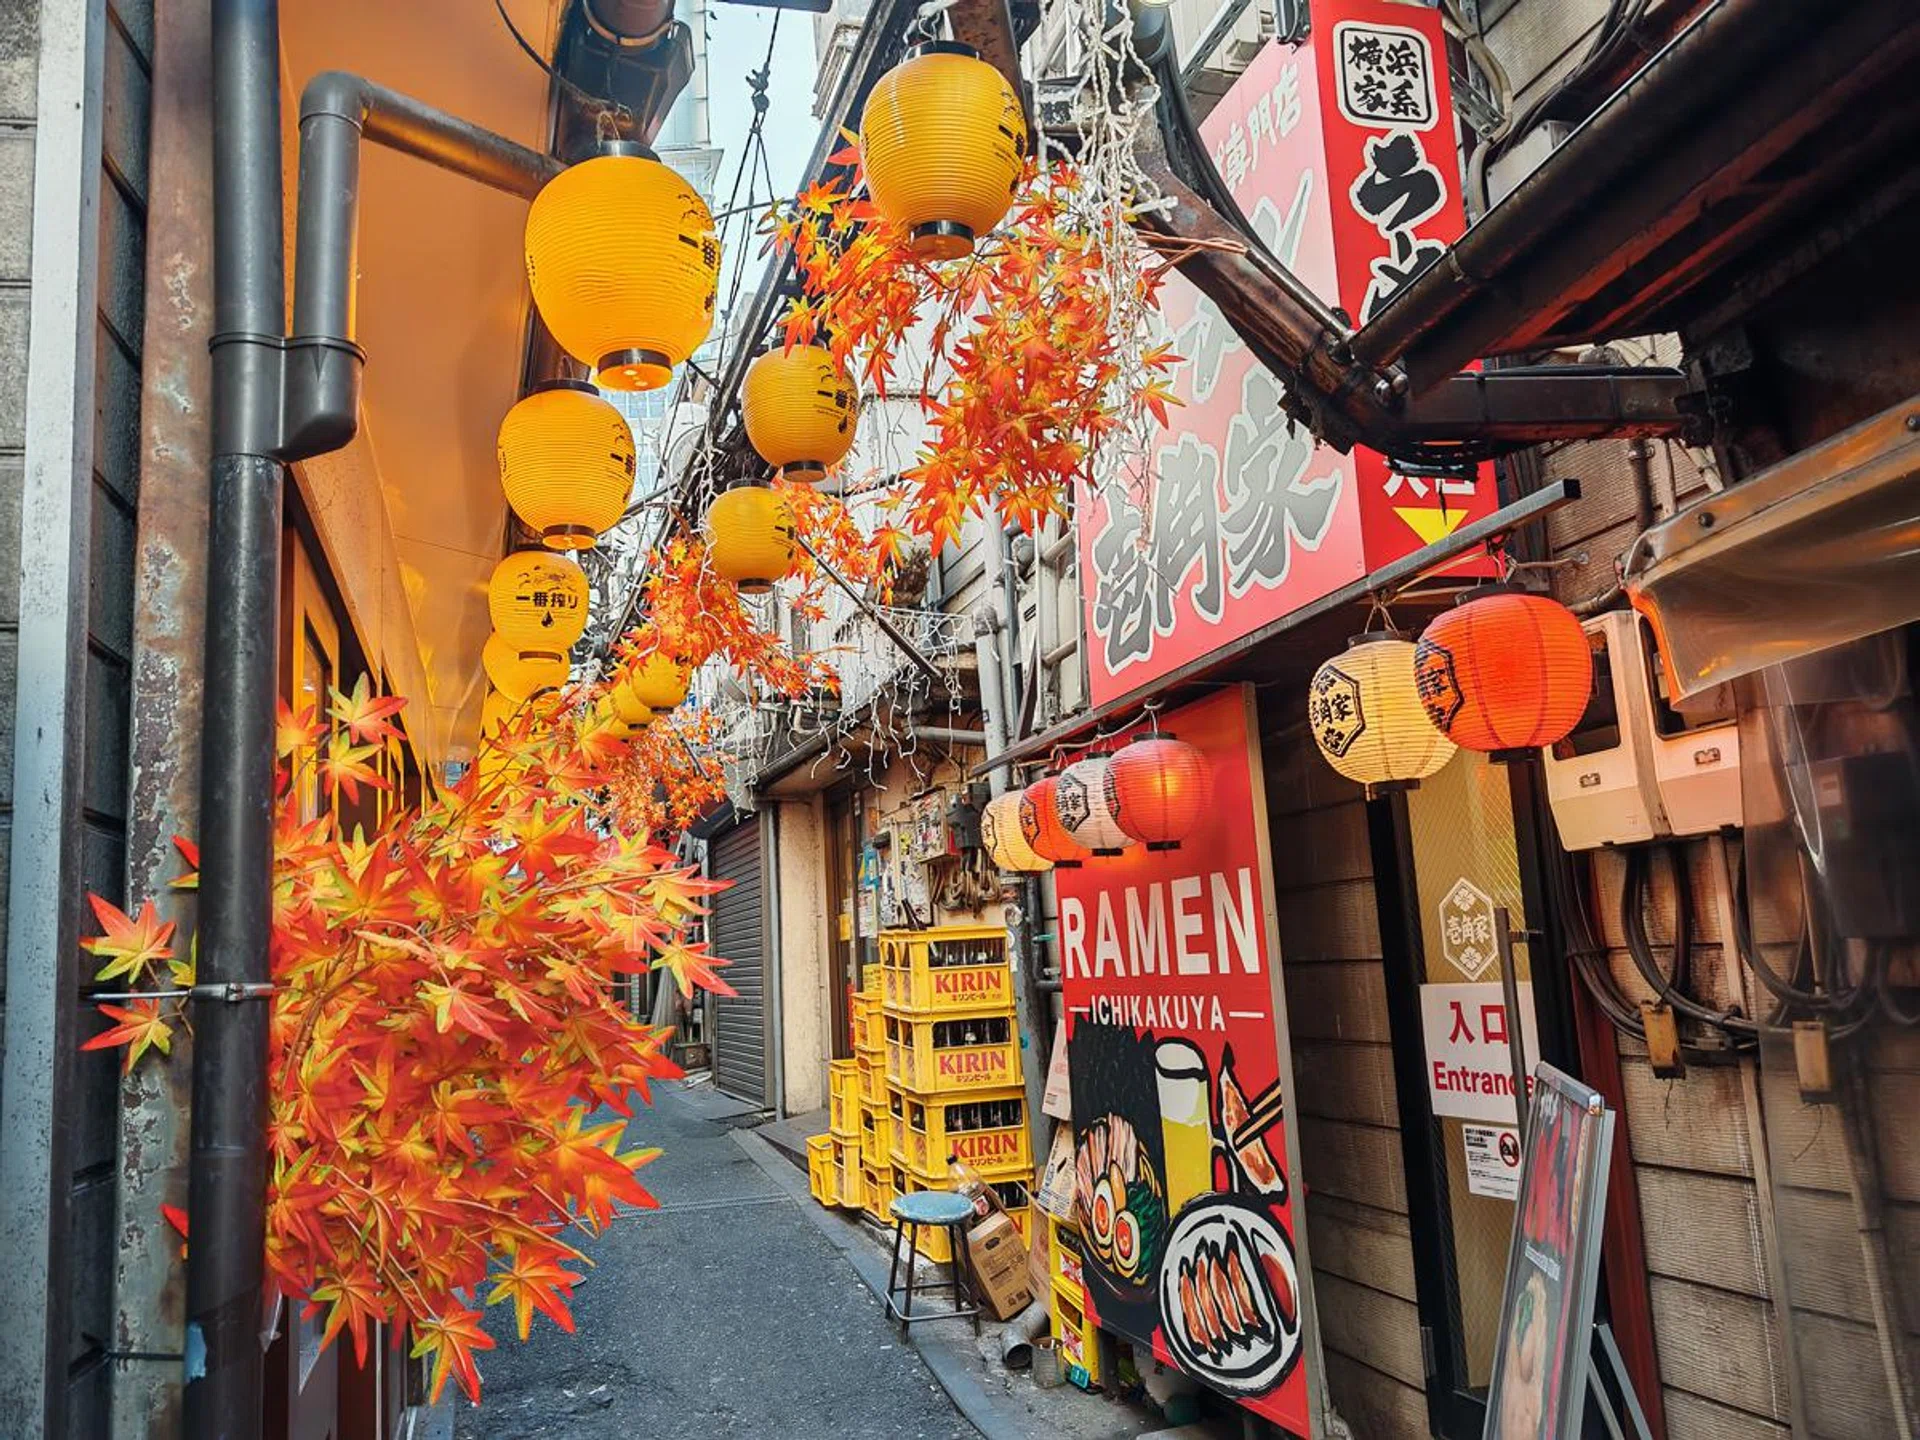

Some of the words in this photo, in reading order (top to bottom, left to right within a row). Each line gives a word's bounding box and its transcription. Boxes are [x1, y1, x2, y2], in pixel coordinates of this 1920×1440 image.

[1347, 35, 1420, 78] 横浜
[1353, 74, 1422, 117] 家系
[516, 592, 577, 609] 一番搾り
[1061, 867, 1261, 979] RAMEN
[935, 970, 1001, 993] KIRIN
[1091, 994, 1226, 1032] ICHIKAKUYA
[1449, 1001, 1508, 1044] 入口
[939, 1049, 1006, 1075] KIRIN
[952, 1133, 1018, 1158] KIRIN
